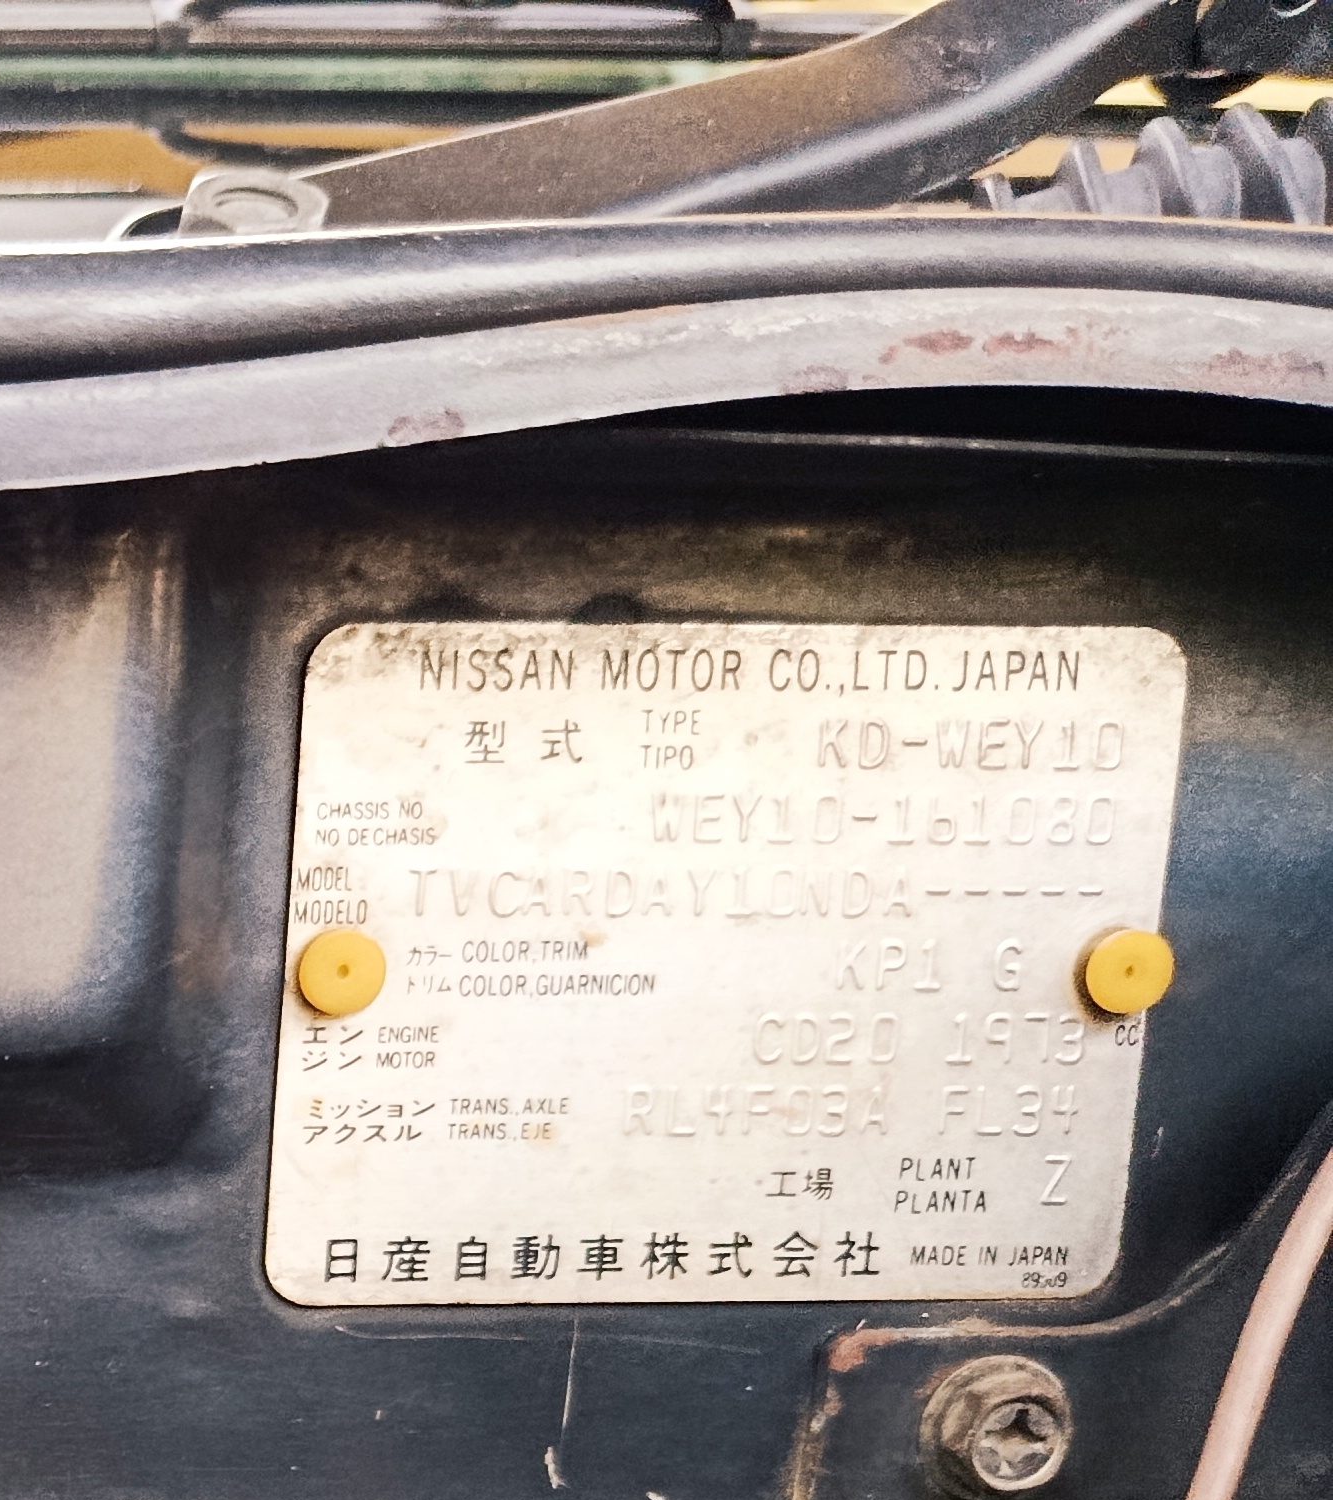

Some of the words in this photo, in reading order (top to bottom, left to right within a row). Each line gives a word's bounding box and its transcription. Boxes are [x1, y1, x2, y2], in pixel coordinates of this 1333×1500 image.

[418, 648, 575, 692] NISSAN
[600, 648, 742, 692] MOTOR
[640, 709, 702, 736] TYPE
[640, 744, 694, 771] TIPO
[817, 718, 1125, 772] KD-WEY10
[316, 801, 390, 821] CHASSIS
[399, 801, 423, 821] NO
[649, 793, 1116, 845] WEY10-161080
[315, 827, 340, 847] NO
[296, 866, 353, 892] MODEL
[293, 899, 368, 926] MODELO
[833, 938, 942, 993] KP1
[993, 938, 1024, 993] G
[377, 1025, 440, 1045] ENGINE
[752, 1012, 900, 1066] CD20
[944, 1012, 1086, 1066] 1973
[375, 1051, 435, 1070] MOTOR
[938, 1084, 1079, 1137] FL34
[302, 1123, 422, 1145] アクスル
[899, 1156, 976, 1182] PLANT
[1040, 1154, 1072, 1207] Z
[765, 1167, 834, 1200] 工場
[894, 1190, 987, 1215] PLANTA
[324, 1230, 881, 1283] 日産自動車株式会社
[909, 1245, 966, 1266] MADE
[978, 1245, 998, 1266] IN
[1007, 1245, 1069, 1266] JAPAN
